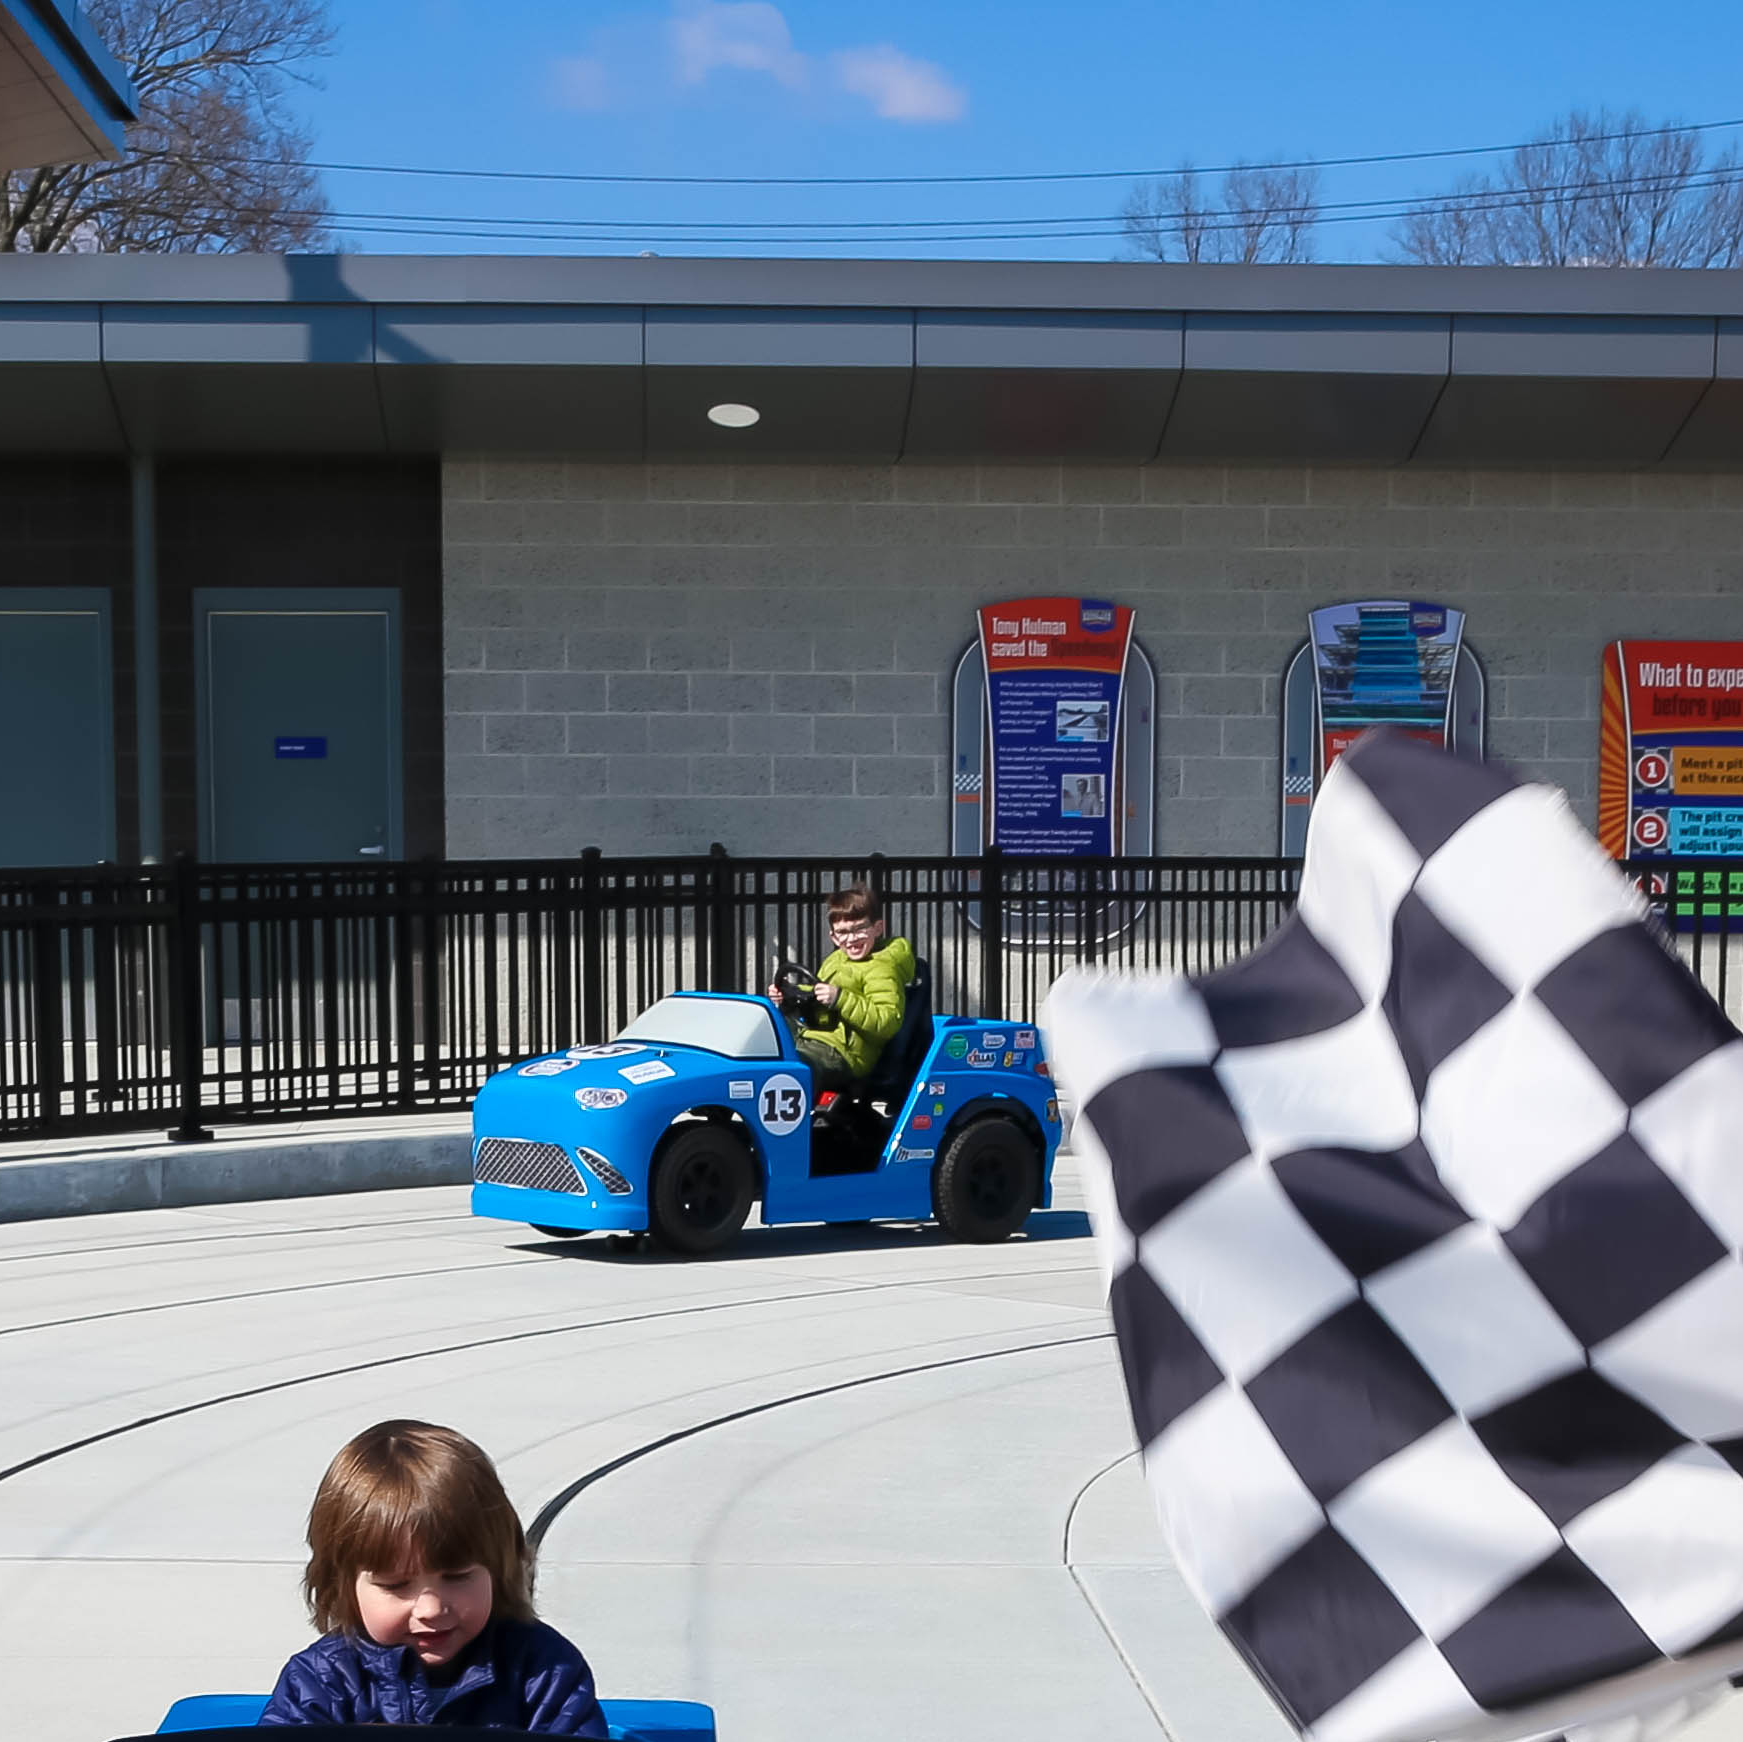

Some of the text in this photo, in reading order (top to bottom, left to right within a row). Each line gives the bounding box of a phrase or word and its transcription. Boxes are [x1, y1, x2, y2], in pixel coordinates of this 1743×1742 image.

[991, 616, 1019, 638] Tony
[1022, 616, 1067, 635] Hulman
[991, 640, 1026, 657] saved
[1028, 640, 1048, 657] the
[1639, 662, 1682, 687] What
[1686, 663, 1703, 687] to
[1652, 693, 1707, 717] before
[1711, 698, 1743, 721] you
[1646, 761, 1658, 779] 1
[1681, 758, 1715, 769] Meet
[1716, 761, 1724, 769] a
[1726, 758, 1743, 772] pit
[1681, 773, 1694, 783] at
[1698, 772, 1719, 784] the
[1680, 811, 1703, 822] The
[1705, 811, 1722, 824] pit
[1643, 822, 1659, 839] 2
[1679, 826, 1700, 837] will
[1702, 826, 1742, 840] assign
[1679, 841, 1717, 853] adjust
[763, 1089, 802, 1122] 13
